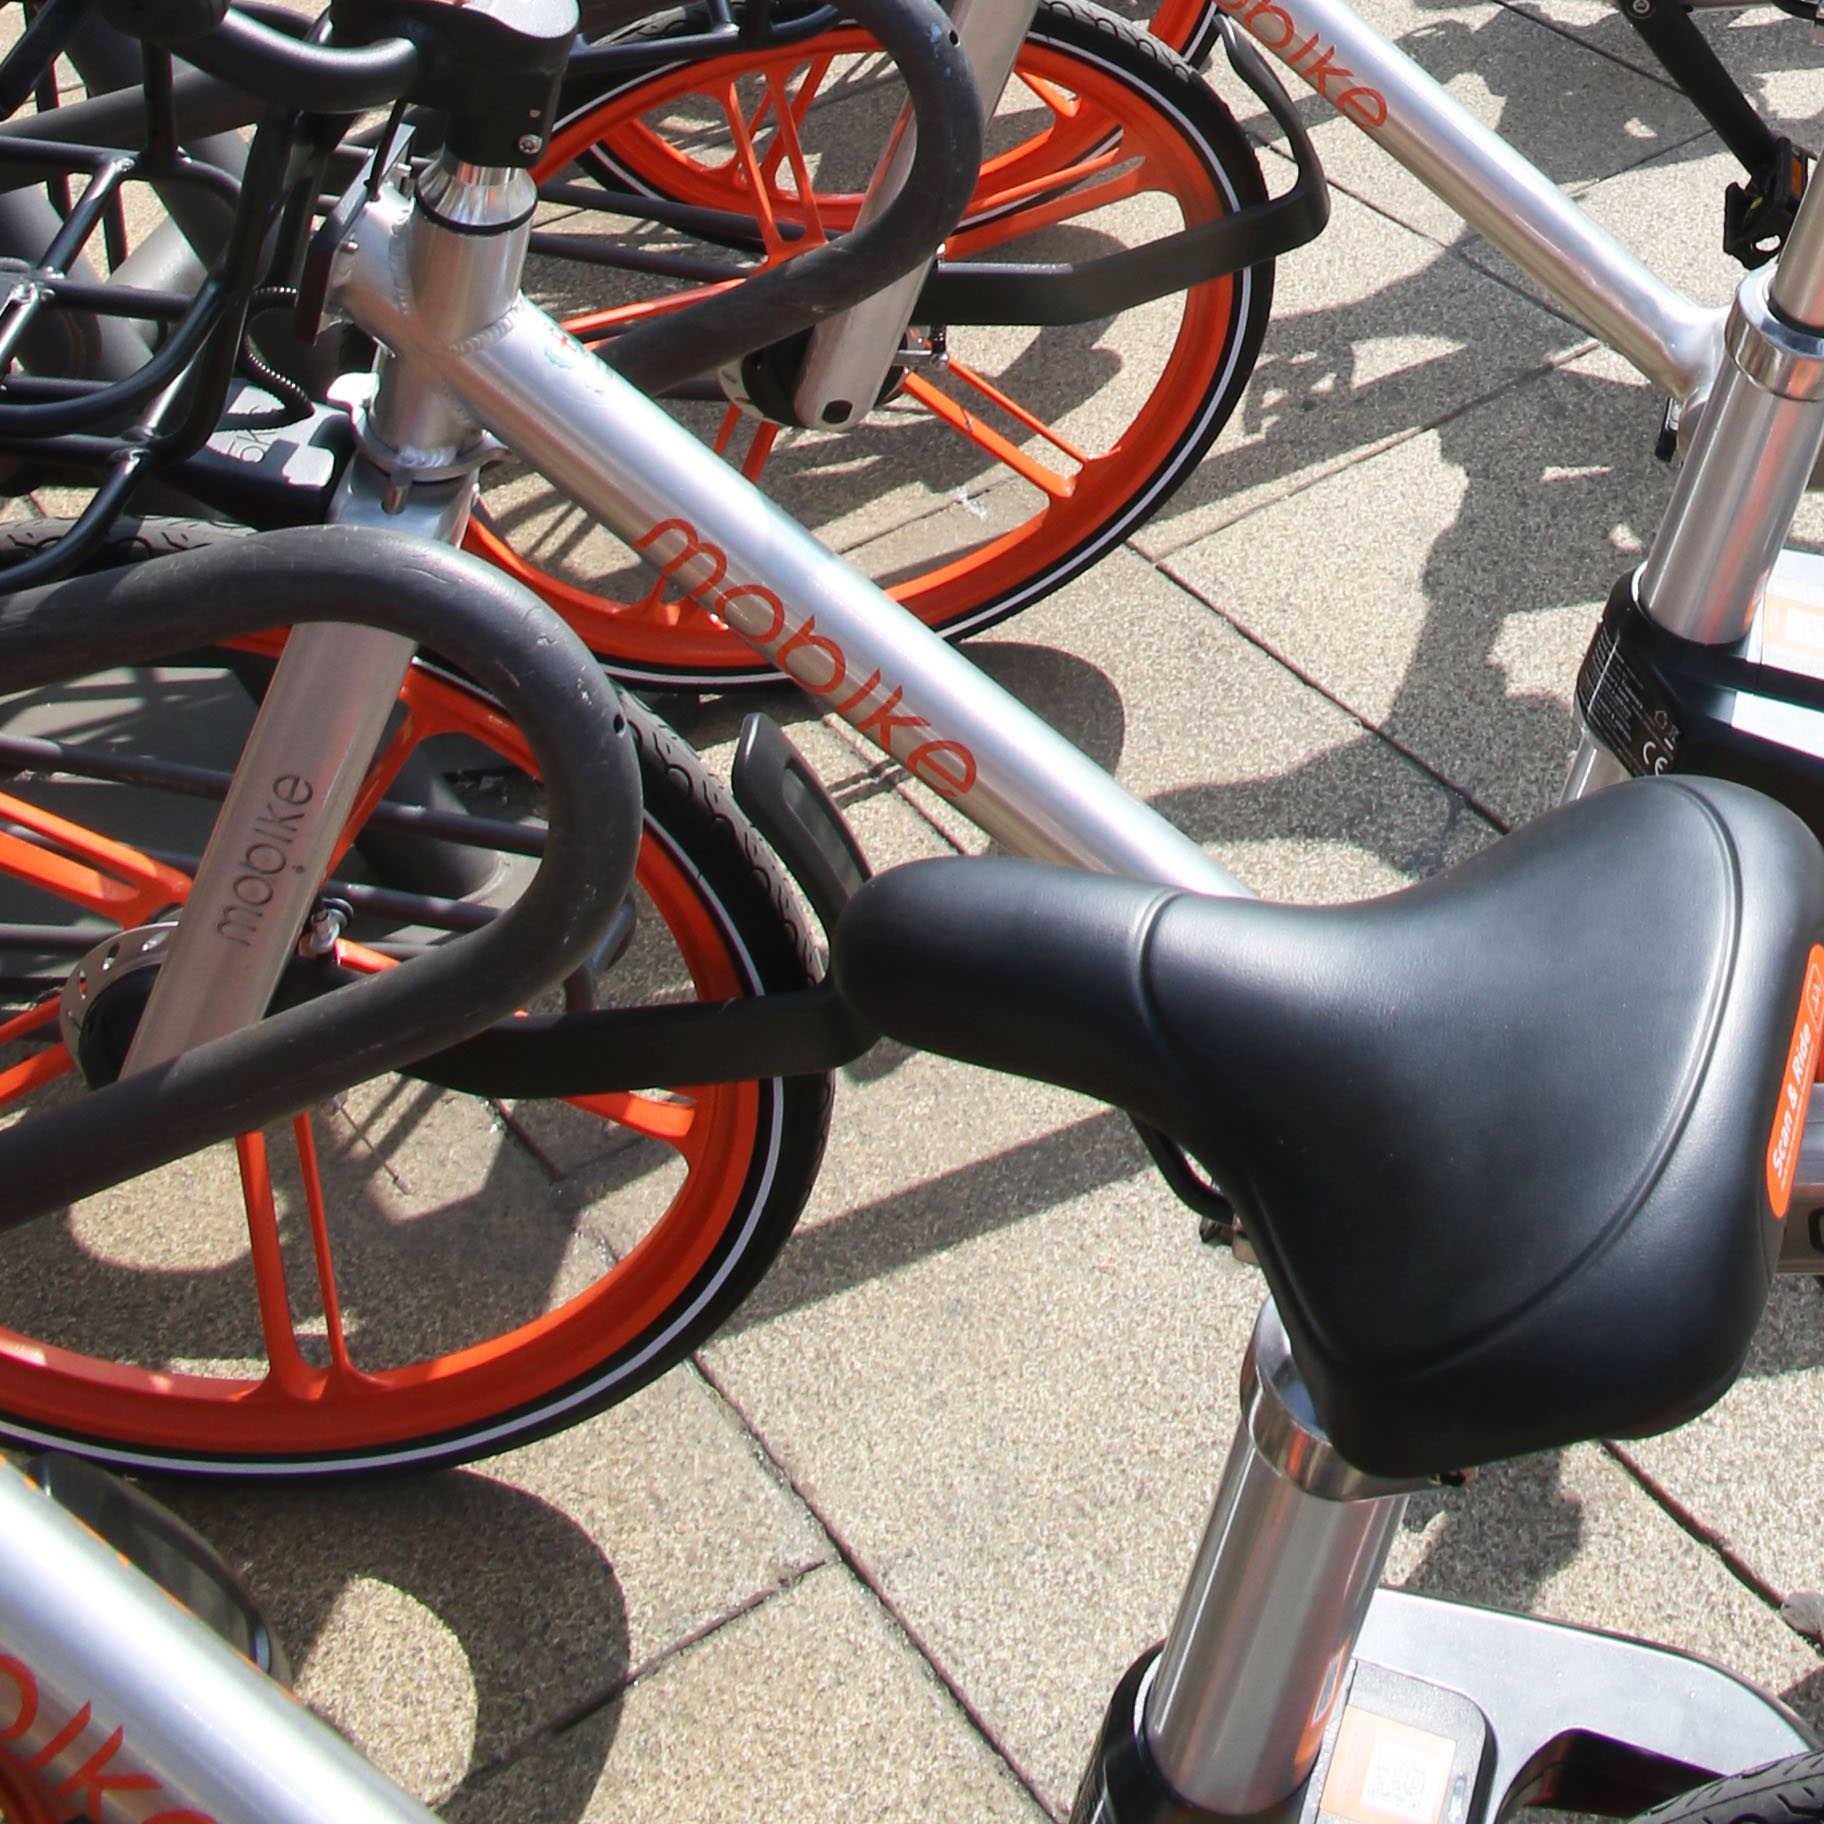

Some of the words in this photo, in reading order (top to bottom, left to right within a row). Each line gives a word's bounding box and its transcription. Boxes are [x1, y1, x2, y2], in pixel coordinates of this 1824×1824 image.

[633, 518, 978, 799] mobike
[216, 774, 314, 947] mobike
[1791, 1023, 1812, 1085] Ride
[1786, 1084, 1799, 1111] &
[1772, 1115, 1794, 1178] Scan
